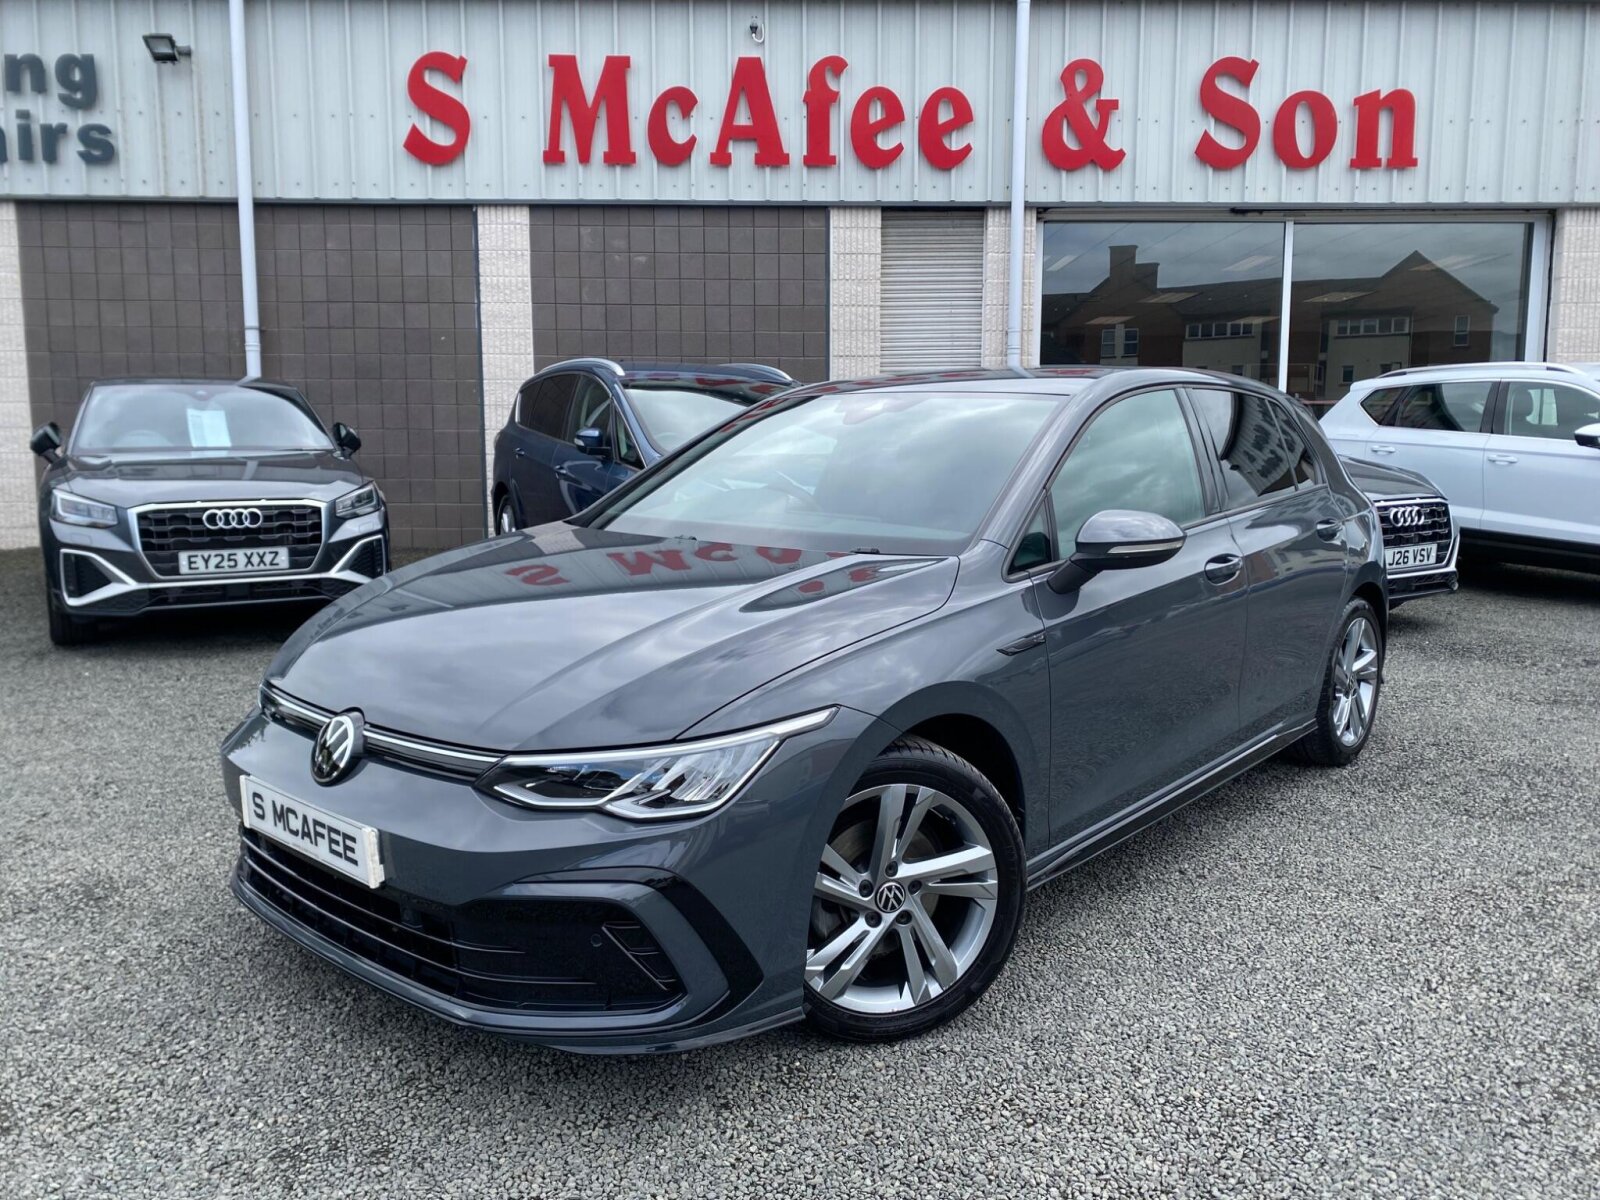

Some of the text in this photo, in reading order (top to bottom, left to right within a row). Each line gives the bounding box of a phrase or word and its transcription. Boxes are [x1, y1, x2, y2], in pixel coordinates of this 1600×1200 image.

[0, 109, 115, 165] irs
[403, 51, 1417, 171] S McAfee & Son
[187, 551, 280, 570] EY25 XXZ
[1412, 547, 1433, 563] VSV
[252, 792, 358, 866] S MCAFEE
